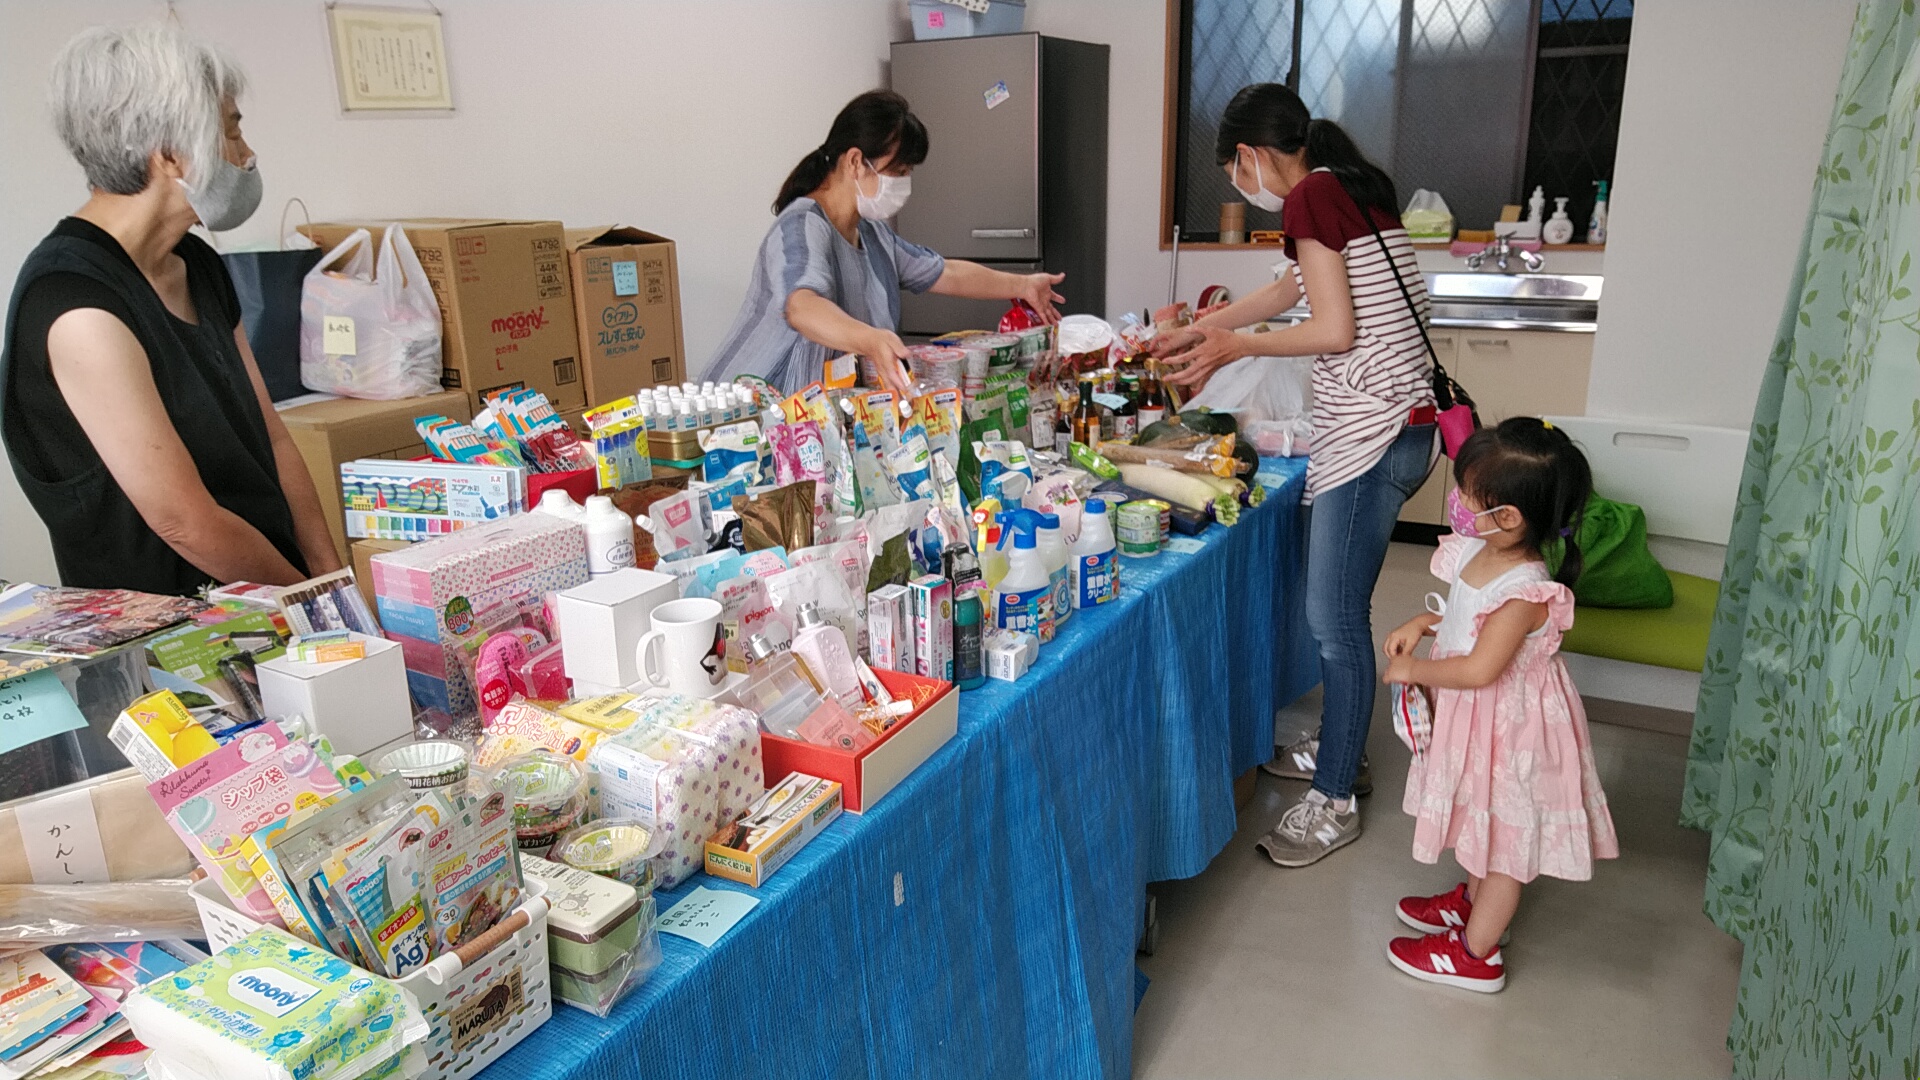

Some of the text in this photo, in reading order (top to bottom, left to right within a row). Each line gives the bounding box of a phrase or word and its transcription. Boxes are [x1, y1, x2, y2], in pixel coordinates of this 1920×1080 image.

[416, 248, 443, 262] 4792
[532, 239, 560, 250] 14792
[539, 263, 558, 274] 44枚
[491, 305, 545, 333] moony
[597, 325, 646, 347] ズレずに安心
[496, 358, 505, 372] L
[447, 611, 469, 631] 800
[744, 605, 775, 625] pigeon
[1292, 751, 1318, 772] N
[220, 764, 289, 810] ジップ袋
[1314, 823, 1339, 846] N
[46, 824, 84, 884] かんし
[708, 854, 752, 874] にんにく絞り器
[1438, 908, 1466, 928] N
[1429, 952, 1457, 974] N
[238, 975, 300, 1008] moony
[457, 998, 506, 1040] MARUTA
